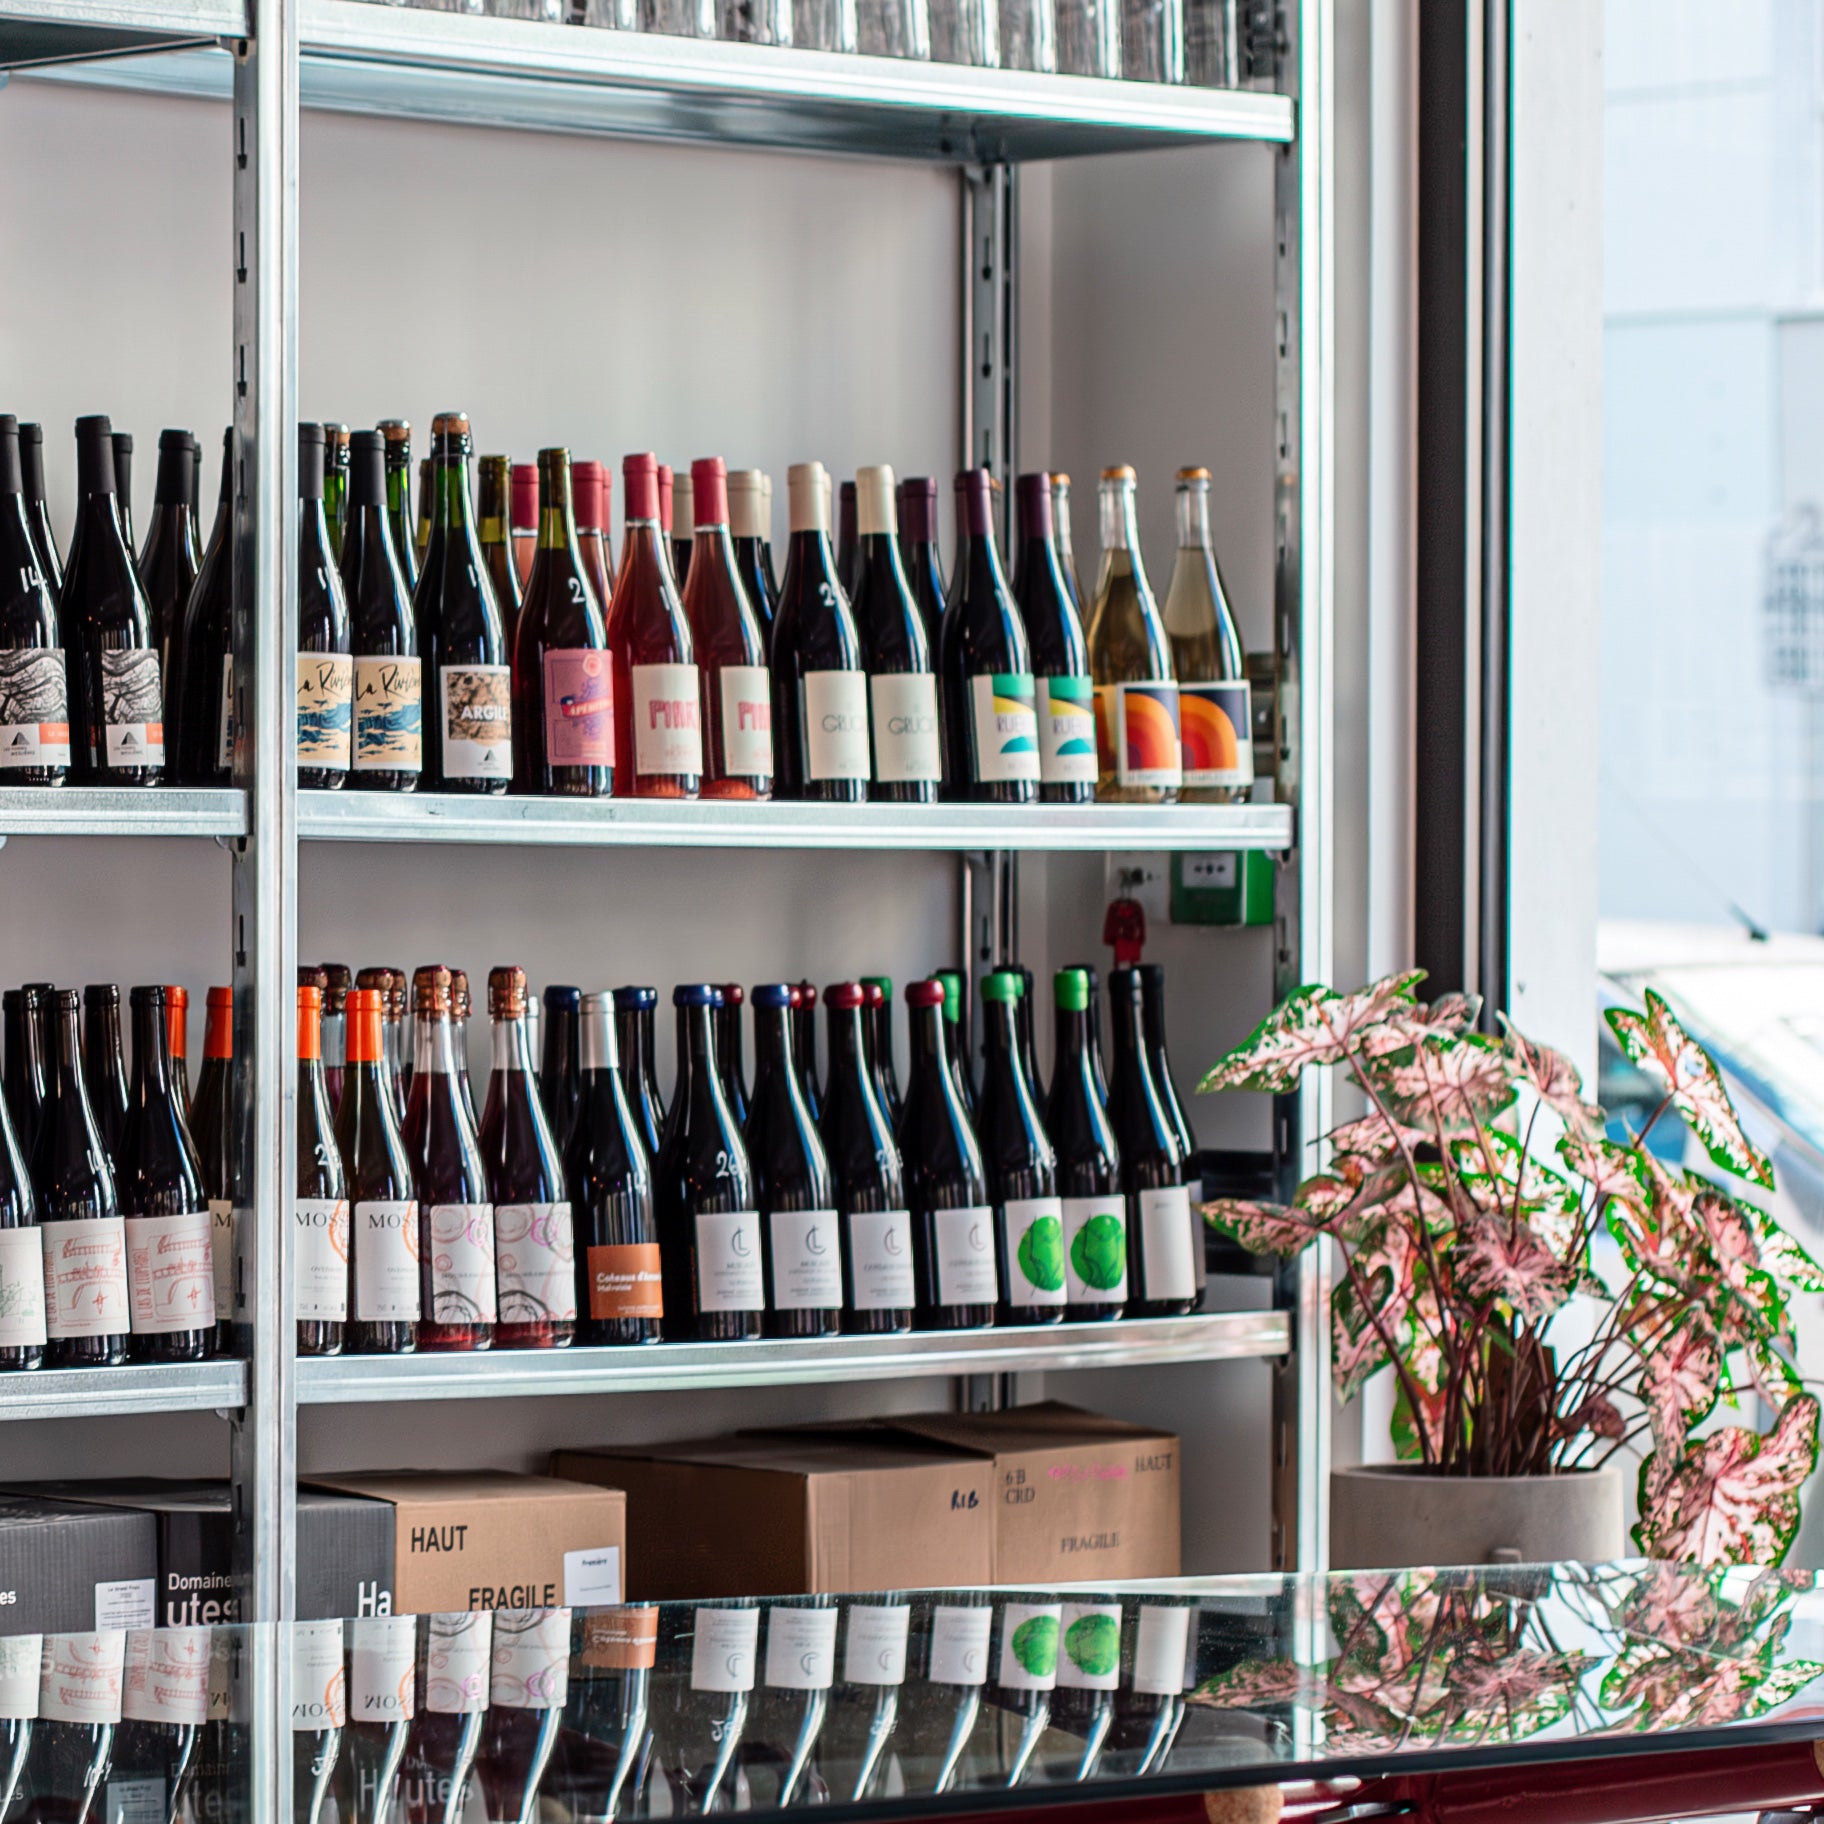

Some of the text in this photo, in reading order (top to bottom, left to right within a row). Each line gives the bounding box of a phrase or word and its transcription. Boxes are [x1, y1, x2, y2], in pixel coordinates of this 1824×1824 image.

[1135, 1453, 1173, 1473] HAUT
[411, 1525, 468, 1553] HAUT
[1061, 1532, 1120, 1553] FRAGILE
[469, 1584, 556, 1612] FRAGILE
